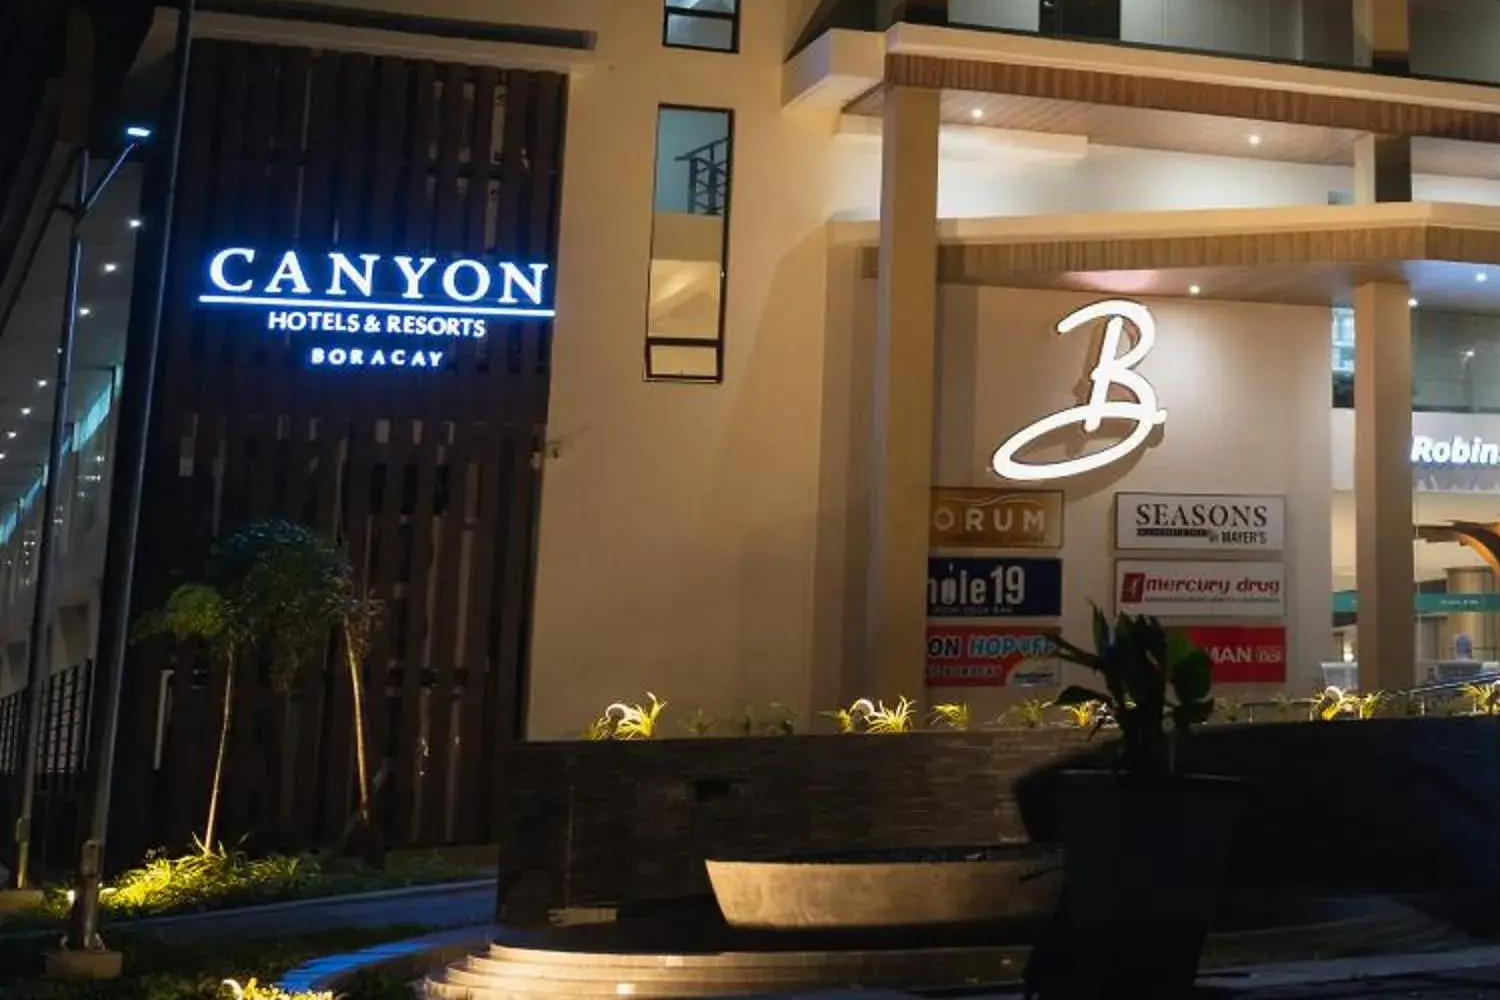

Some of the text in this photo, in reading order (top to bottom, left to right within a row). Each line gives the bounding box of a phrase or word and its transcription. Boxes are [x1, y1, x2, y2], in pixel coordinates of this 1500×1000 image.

[209, 247, 549, 304] CANYON
[268, 311, 487, 338] HOTELS & RESORTS
[310, 347, 444, 367] BORACAY
[991, 299, 1168, 480] B
[934, 506, 1046, 533] ORUM
[1135, 503, 1268, 528] SEASONS
[1146, 575, 1281, 596] mercury drug
[927, 635, 961, 658] ON
